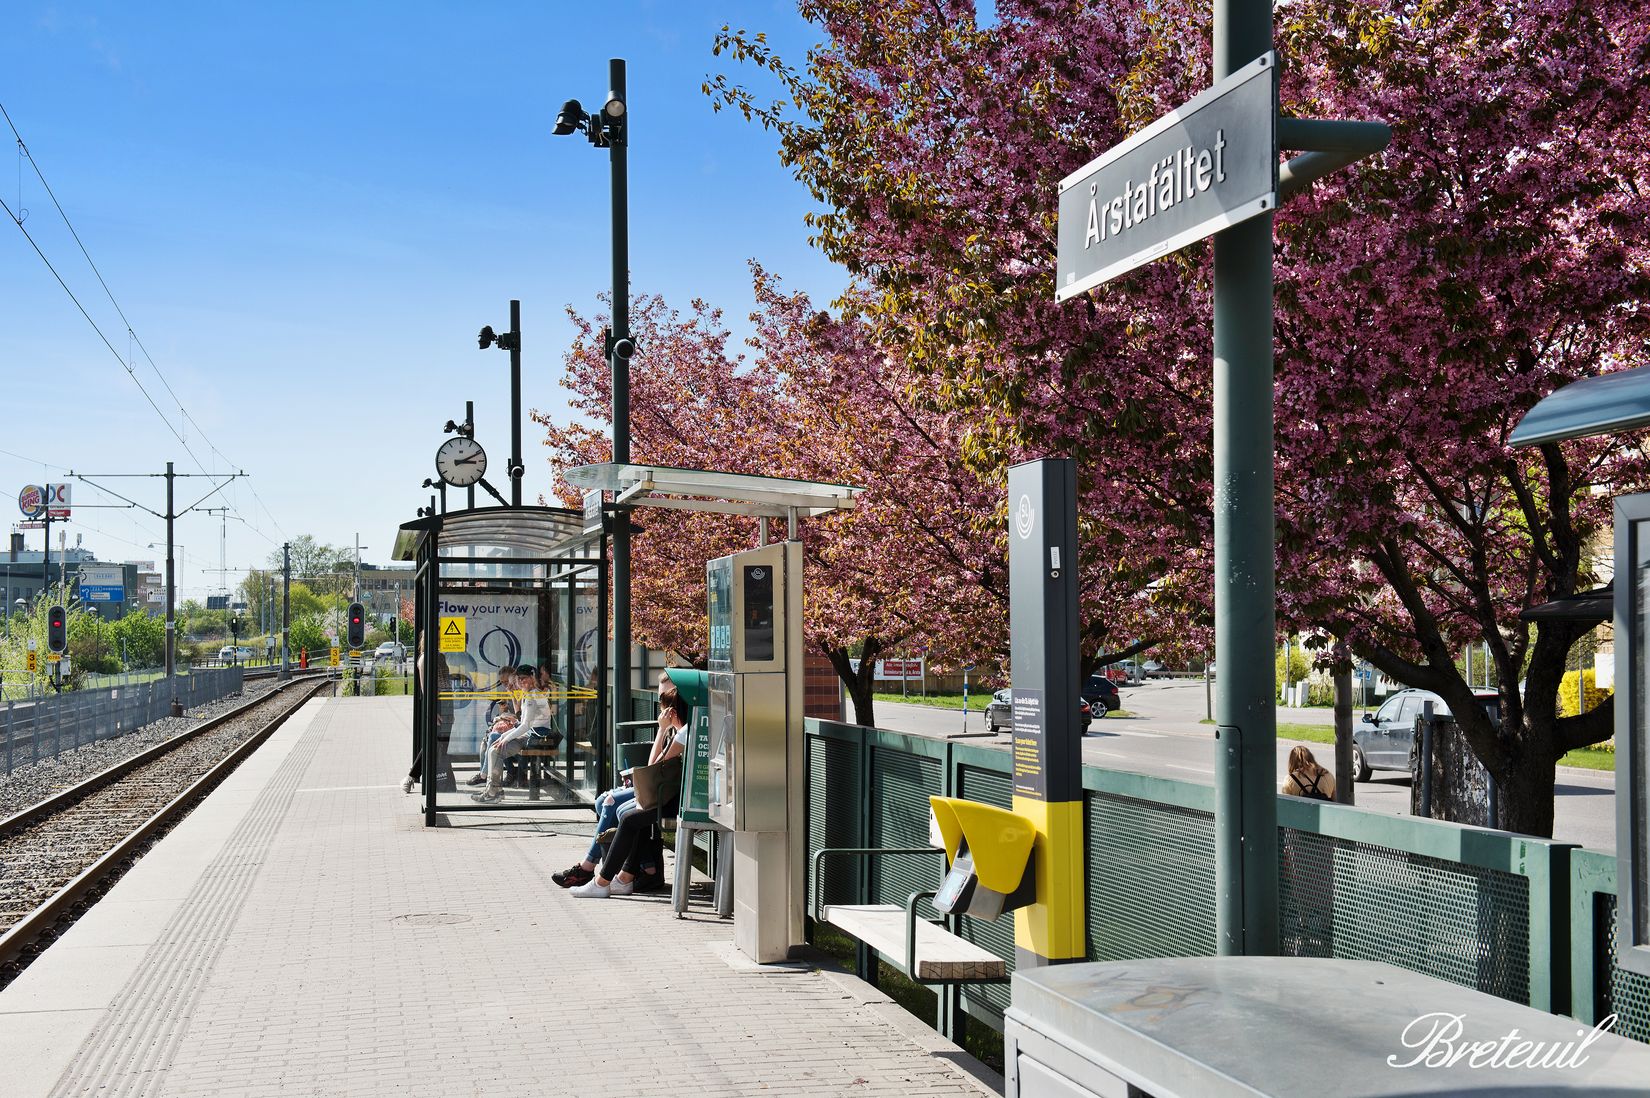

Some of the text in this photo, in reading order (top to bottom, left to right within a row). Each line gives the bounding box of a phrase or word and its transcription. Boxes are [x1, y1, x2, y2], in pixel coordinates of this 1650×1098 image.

[1084, 128, 1226, 250] Årstafältet
[21, 496, 40, 510] KING
[472, 604, 500, 616] your
[503, 604, 529, 616] way
